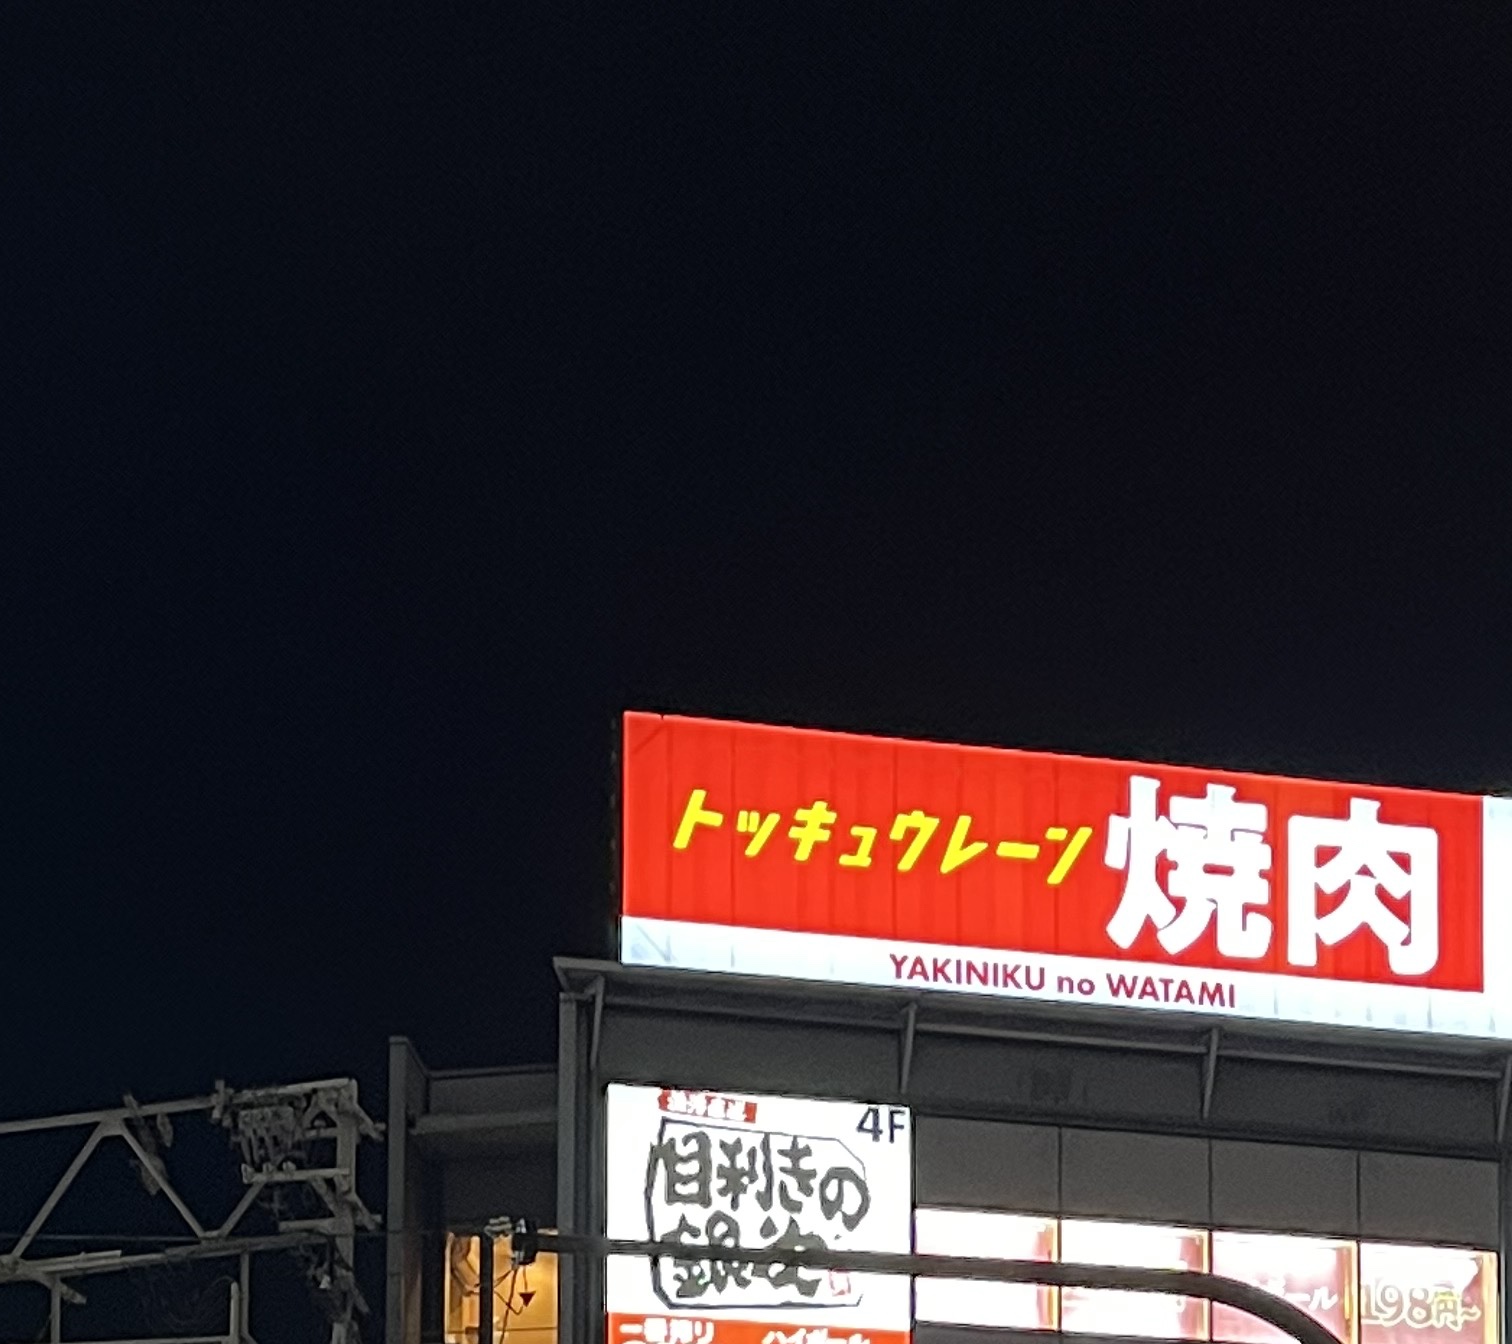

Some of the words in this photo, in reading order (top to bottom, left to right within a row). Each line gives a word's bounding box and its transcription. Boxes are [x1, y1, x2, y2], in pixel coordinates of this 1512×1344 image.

[671, 788, 1093, 886] トッキュウレーン
[1104, 774, 1441, 977] 焼肉
[889, 954, 1047, 992] YAKINIKU
[1056, 975, 1096, 997] no
[1104, 974, 1237, 1009] WATAMI
[856, 1106, 906, 1144] 4F
